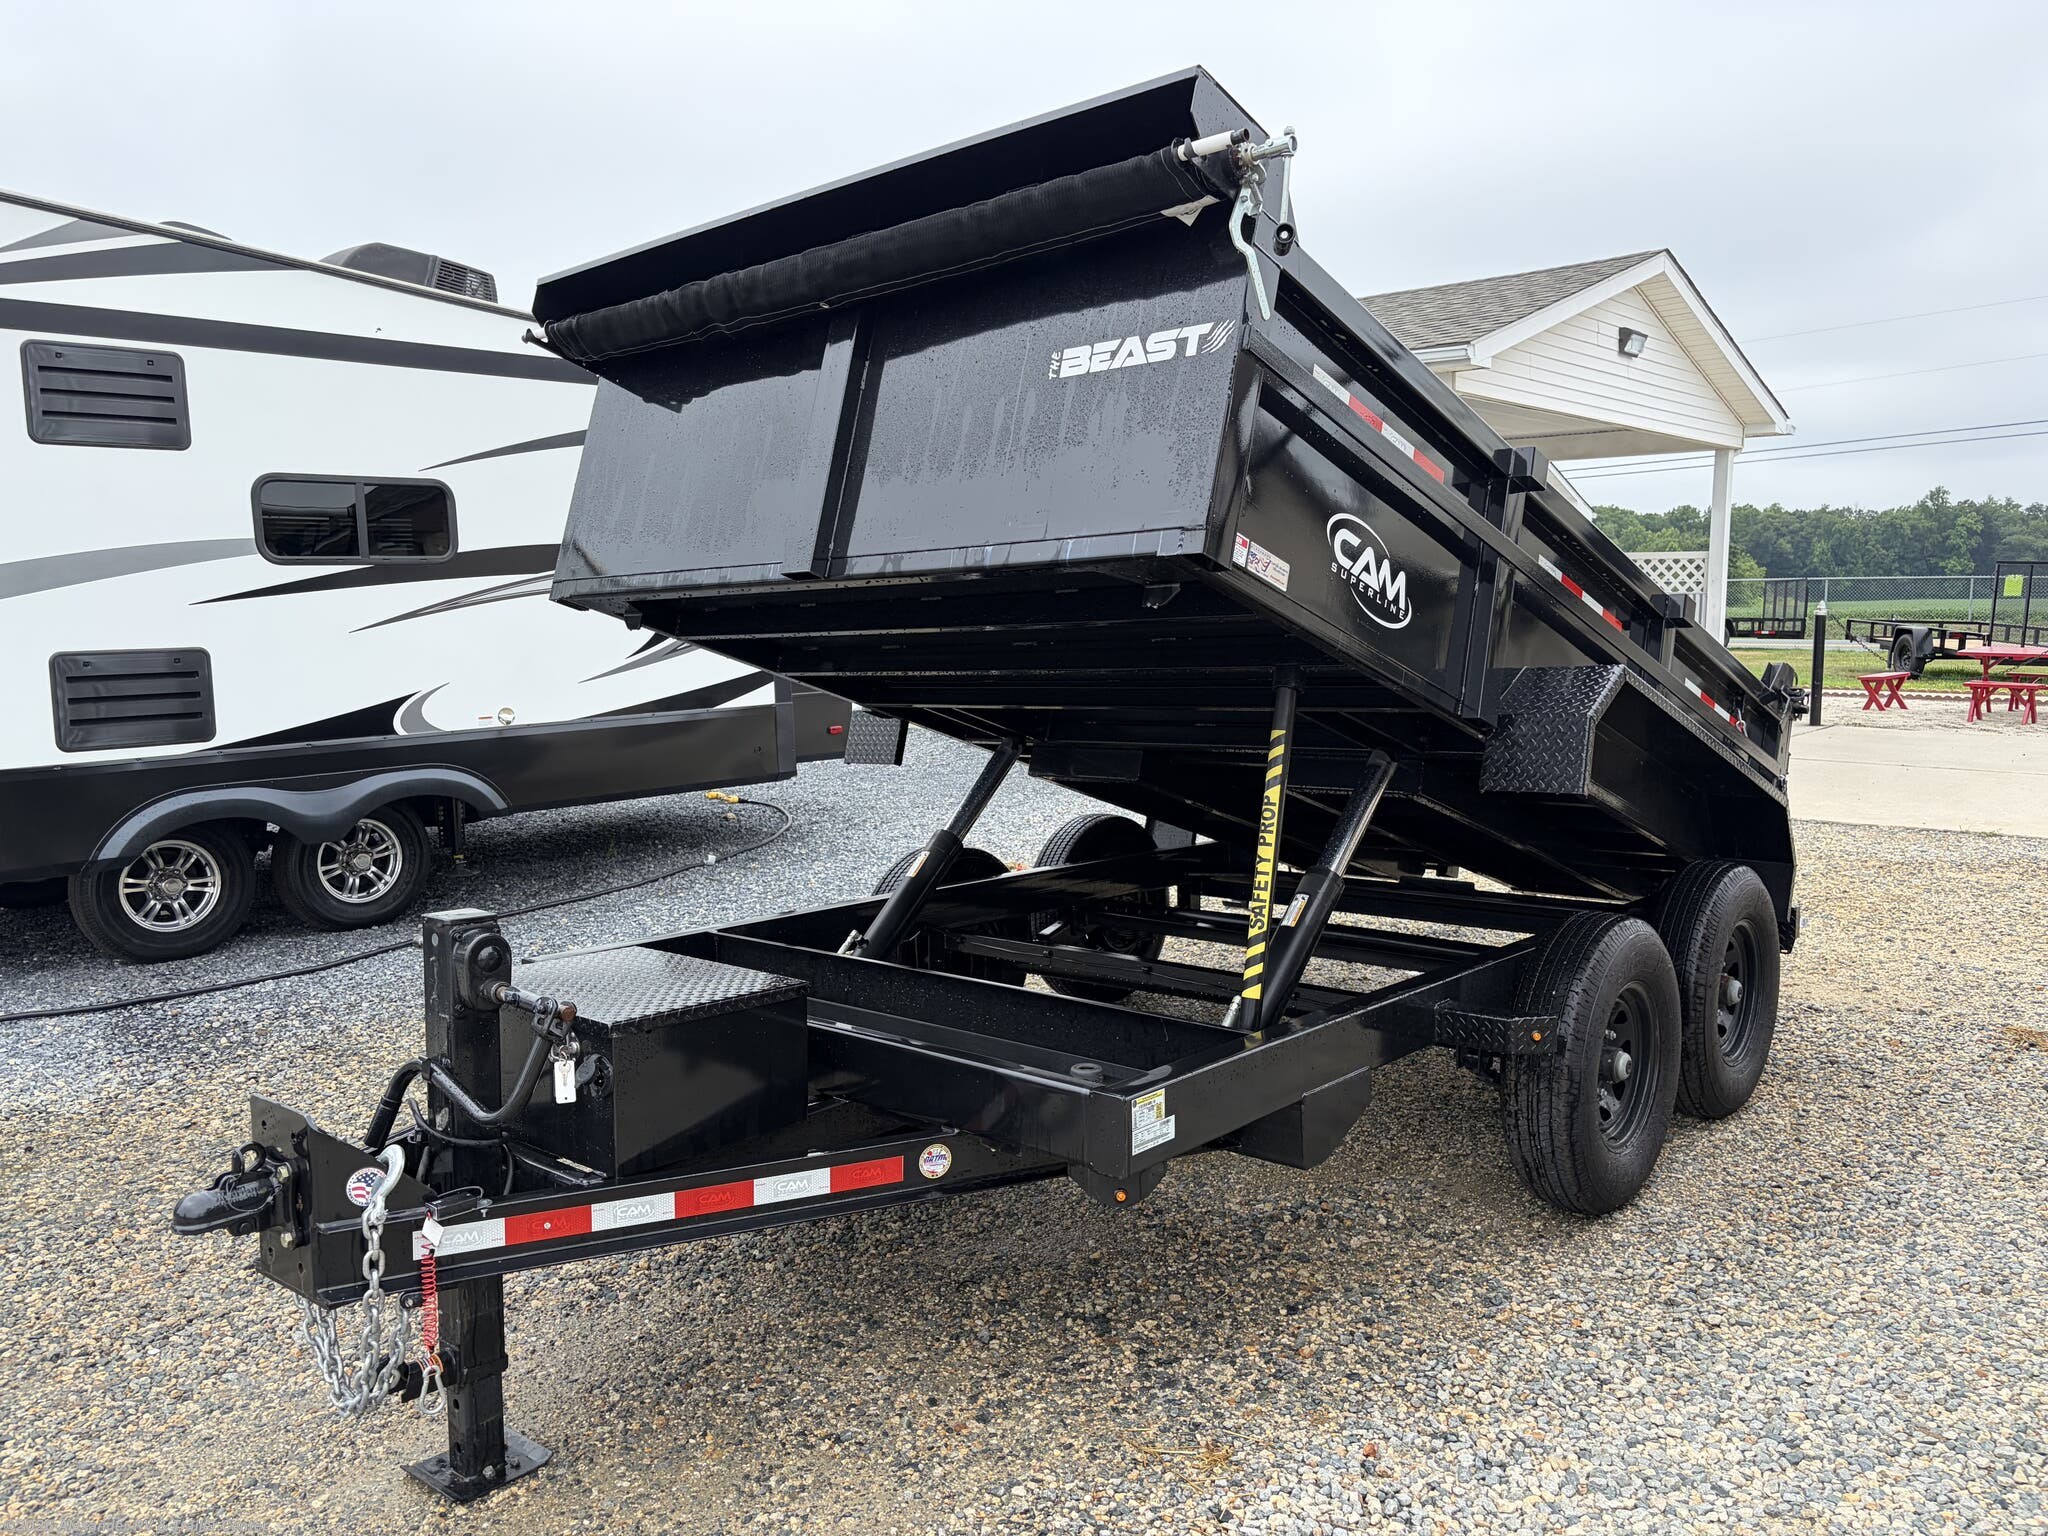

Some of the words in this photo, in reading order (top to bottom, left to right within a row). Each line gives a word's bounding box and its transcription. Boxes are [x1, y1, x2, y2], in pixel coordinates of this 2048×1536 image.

[1059, 322, 1214, 378] BEAST
[1049, 351, 1061, 379] THE
[1334, 529, 1406, 610] CAM
[1331, 562, 1406, 620] SUPERLINE
[1259, 795, 1277, 847] PROP
[1249, 854, 1271, 930] SAFETY
[777, 1179, 809, 1192] CAM
[852, 1167, 882, 1179] CAM
[617, 1204, 651, 1217] CAM
[699, 1191, 731, 1203] CAM
[442, 1231, 479, 1246] CAM
